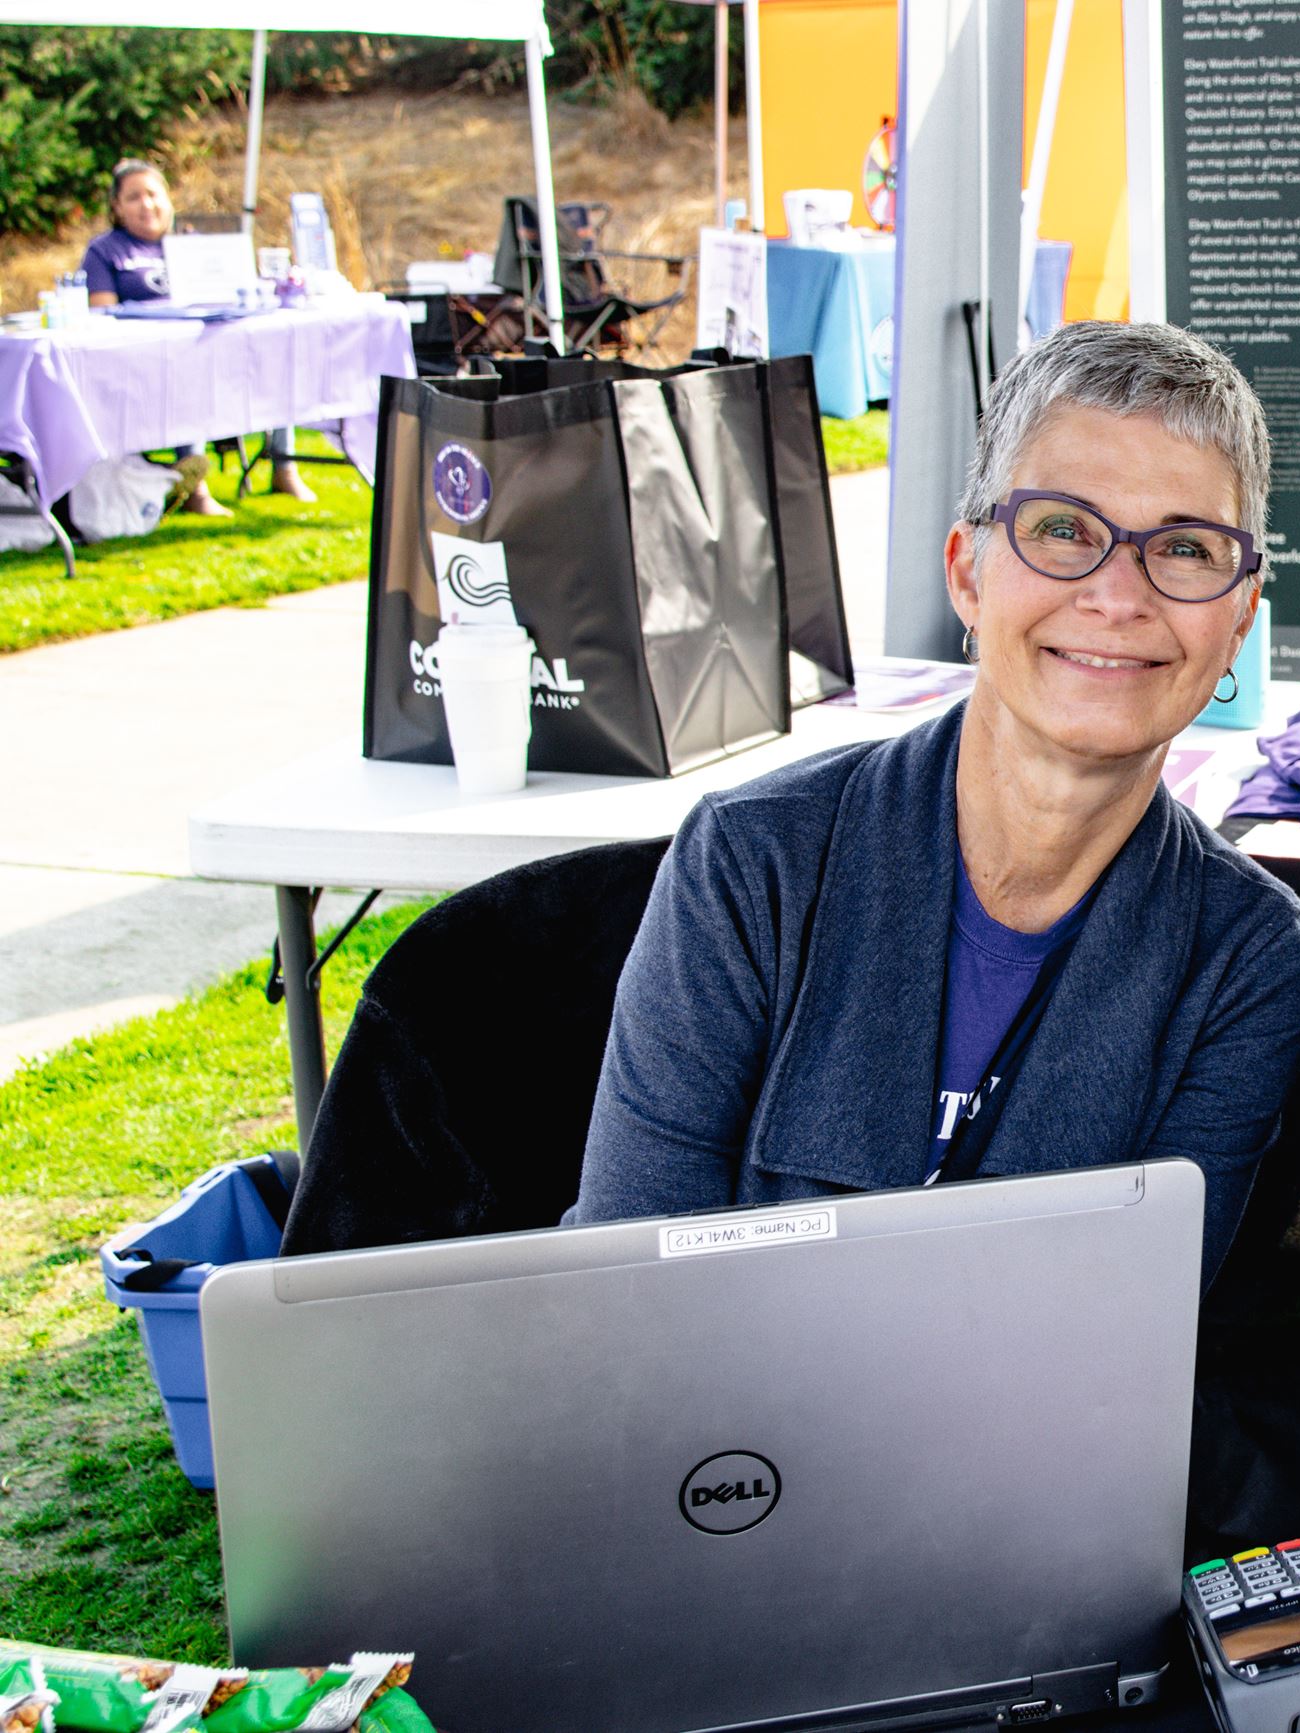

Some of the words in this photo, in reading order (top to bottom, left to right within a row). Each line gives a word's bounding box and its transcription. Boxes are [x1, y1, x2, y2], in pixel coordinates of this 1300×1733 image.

[410, 640, 585, 692] COAL
[751, 1221, 796, 1235] Name:
[800, 1219, 821, 1232] PC
[691, 1478, 770, 1507] DELL
